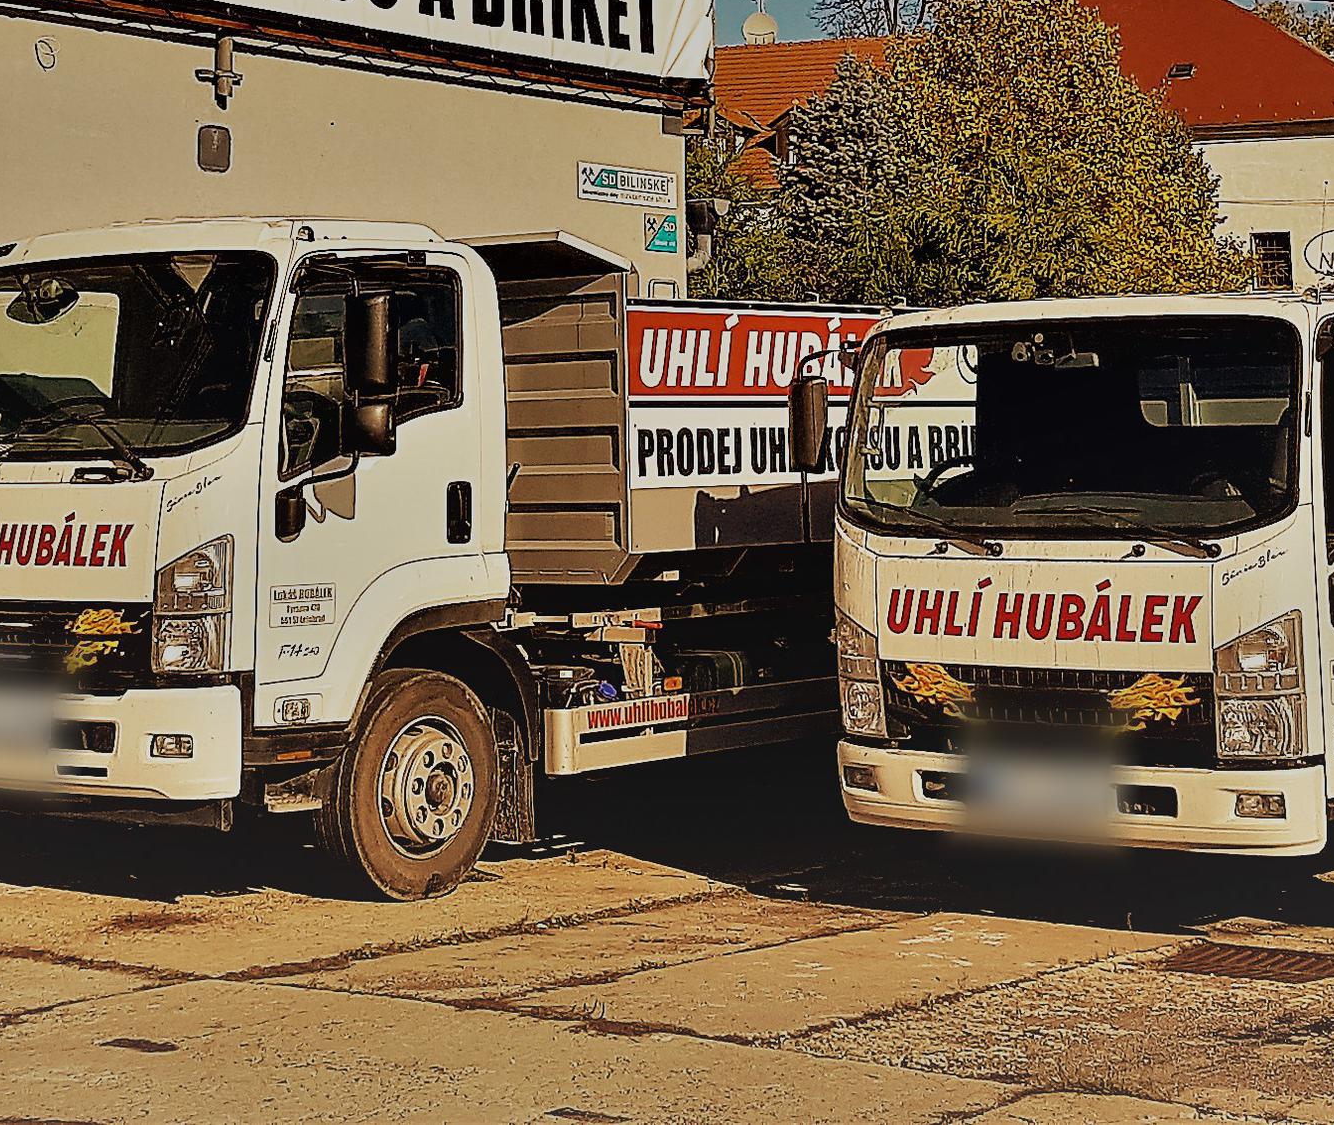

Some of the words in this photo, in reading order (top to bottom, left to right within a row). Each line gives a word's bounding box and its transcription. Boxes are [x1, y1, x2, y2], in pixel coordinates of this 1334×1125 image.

[639, 313, 739, 388] UHLÍ
[637, 427, 742, 477] PRODEJ
[907, 425, 923, 469] A
[887, 577, 992, 636] UHLÍ
[993, 579, 1203, 643] HUBÁLEK
